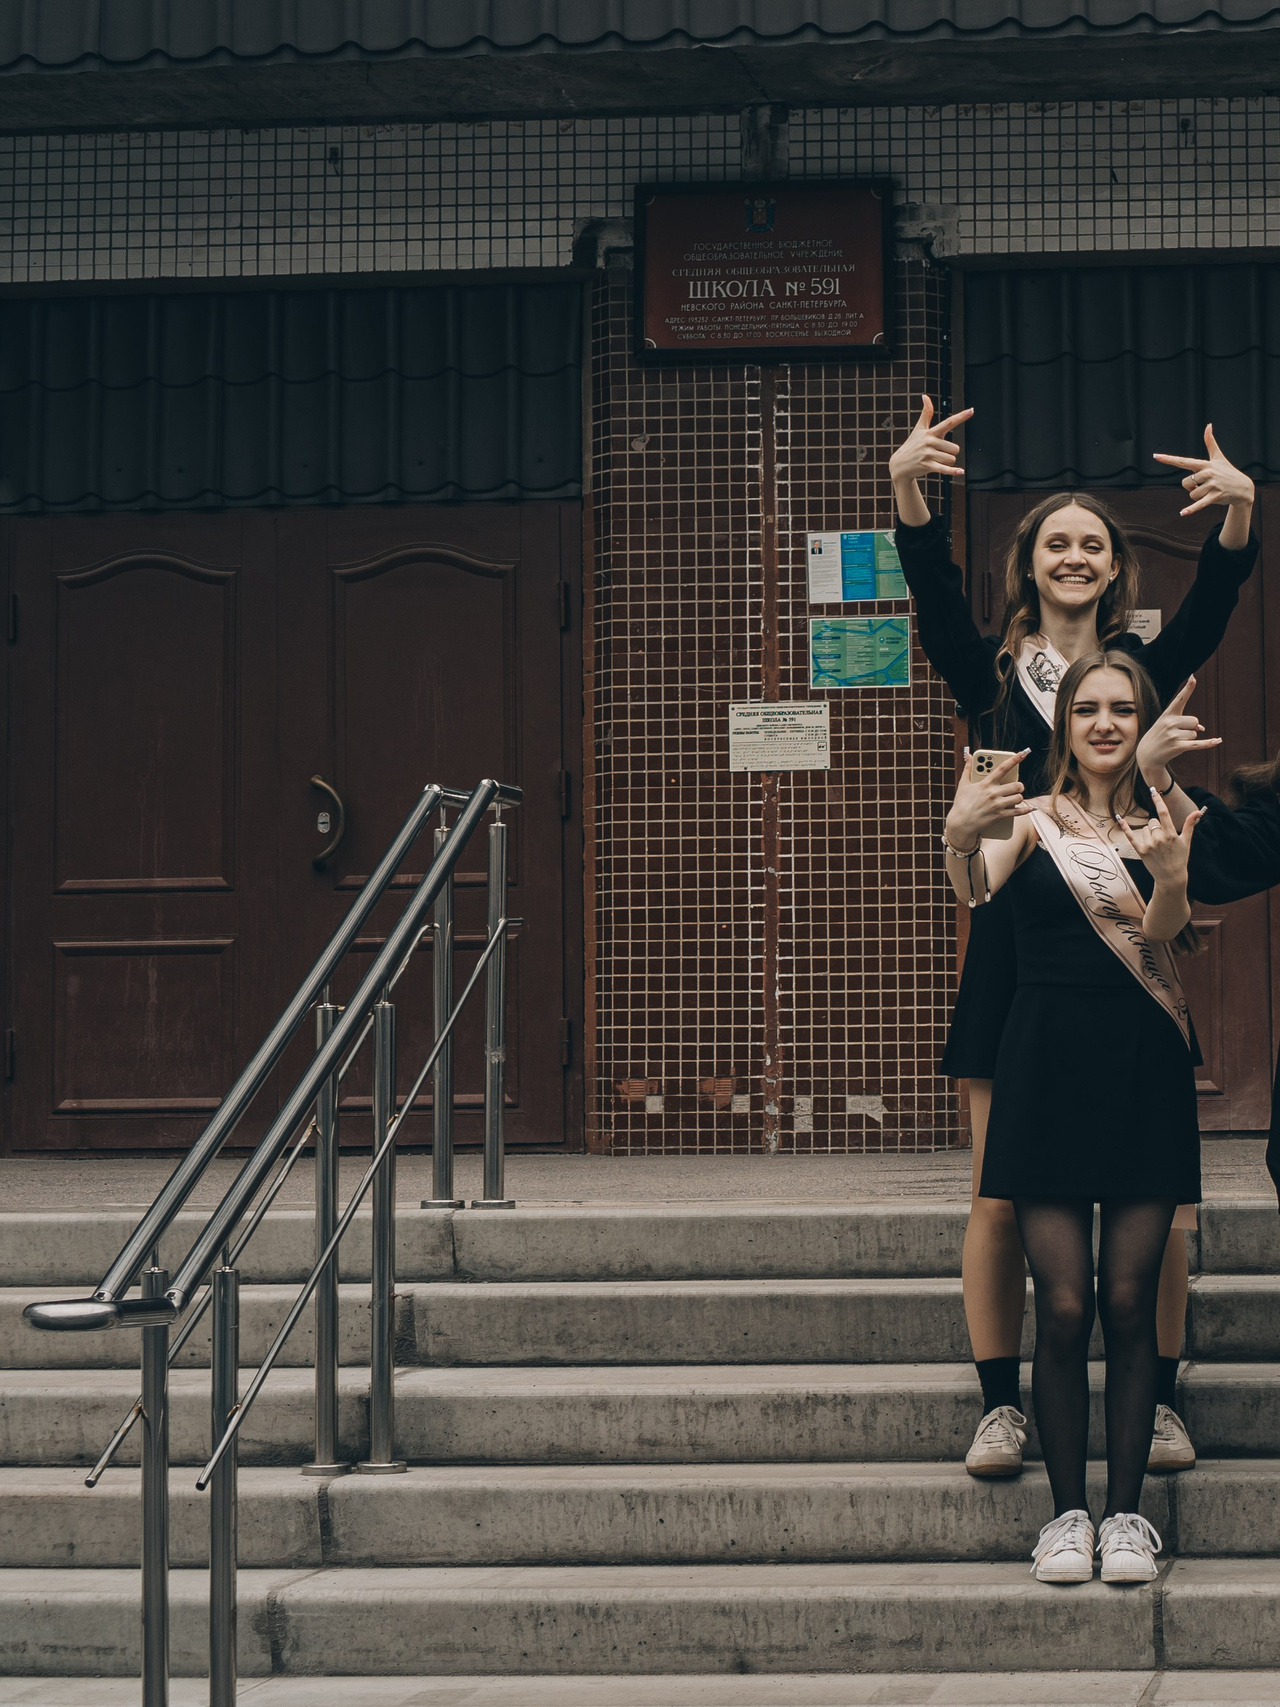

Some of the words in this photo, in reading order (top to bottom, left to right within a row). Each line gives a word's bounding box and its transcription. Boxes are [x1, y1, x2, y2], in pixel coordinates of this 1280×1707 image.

[693, 241, 774, 251] ГОСУДАРСТВЕННОЕ
[778, 239, 833, 249] БЮДЖЕТНОЕ
[683, 251, 785, 262] ОБЩЕОБРАЗОВАТЕЛЬНОЕ
[790, 249, 844, 259] УЧРЕЖДЕНИЕ
[671, 267, 722, 277] СРЕДНЯЯ
[725, 264, 856, 276] ОБЩЕОБРАЗОВАТЕЛЬНАЯ
[688, 279, 776, 299] ШКОЛА
[810, 277, 841, 296] 591
[680, 303, 726, 312] НЕВСКОГО
[730, 301, 765, 310] РАЙОНА
[768, 299, 848, 310] САНКТ-ПЕТЕРБУРГА
[671, 324, 694, 332] РЕЖИМ
